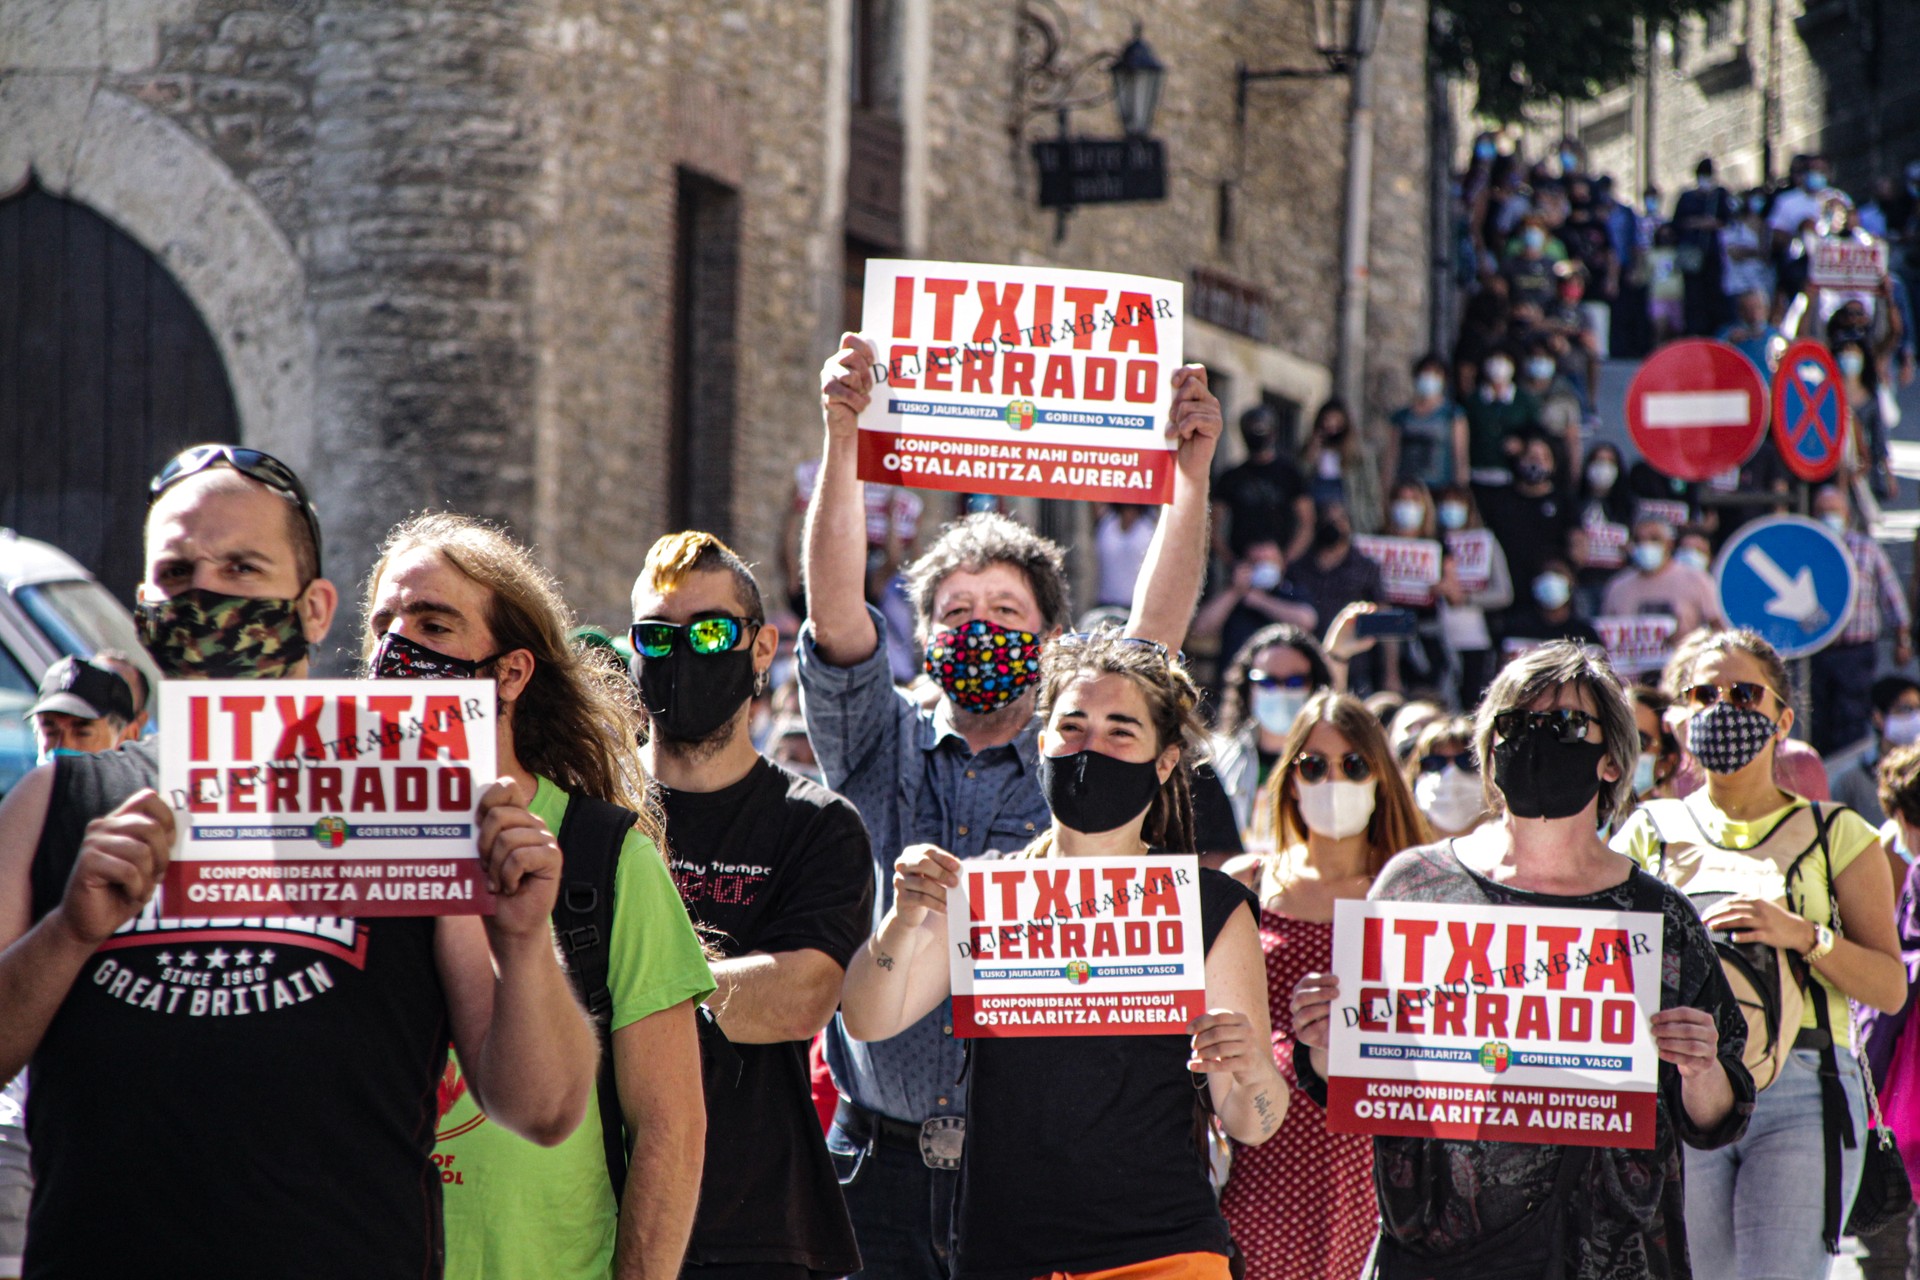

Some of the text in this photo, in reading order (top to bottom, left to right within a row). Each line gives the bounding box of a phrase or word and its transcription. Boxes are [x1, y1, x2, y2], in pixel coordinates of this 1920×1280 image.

[892, 276, 1159, 355] ITXITA
[872, 332, 1016, 385] DEJARNOS
[1019, 298, 1175, 348] TRABAJAR
[888, 344, 1159, 405] CERRADO
[897, 402, 998, 418] EUSKO JAURLARITZA
[1045, 411, 1145, 428] GOBIERNO VASCO
[895, 439, 1139, 467] KONPONBIDEAK NAHI DITUGU!
[883, 454, 1153, 490] OSTALARITZA AURERA!
[188, 695, 470, 761] ITXITA
[170, 697, 486, 811] DEJARNOS TRABAJAR
[188, 767, 471, 813] CERRADO
[199, 828, 307, 839] EUSKO JAURLARITZA
[356, 826, 461, 837] GOBIERNO VASCO
[200, 863, 457, 879] KONPONBIDEAK NAHI DITUGU!
[188, 880, 473, 902] OSTALARITZA AURERA!
[968, 866, 1181, 922] ITXITA
[957, 868, 1191, 958] DEJARNOS TRABAJAR
[970, 920, 1184, 960] CERRADO
[1362, 917, 1635, 994] ITXITA
[161, 966, 266, 987] SINCE 1960
[980, 969, 1060, 979] EUSKO JAURLARITZA
[1097, 966, 1176, 976] GOBIERNO VASCO
[1342, 932, 1653, 1028] DEJARNOS TRABAJAR
[92, 958, 335, 1017] GREAT BRITAIN
[982, 994, 1174, 1008] KONPONBIDEAK NAHI DITUGU!
[974, 1006, 1188, 1026] OSTALARITZA AURERA!
[1359, 987, 1636, 1045] CERRADO
[1369, 1047, 1473, 1061] EUSKO JAURLARITZA
[1520, 1054, 1623, 1068] GOBIERNO VASCO
[1367, 1084, 1617, 1109] KONPONBIDEAK NAHI DITUGU!
[1354, 1100, 1632, 1133] OSTALARITZA AURERA!
